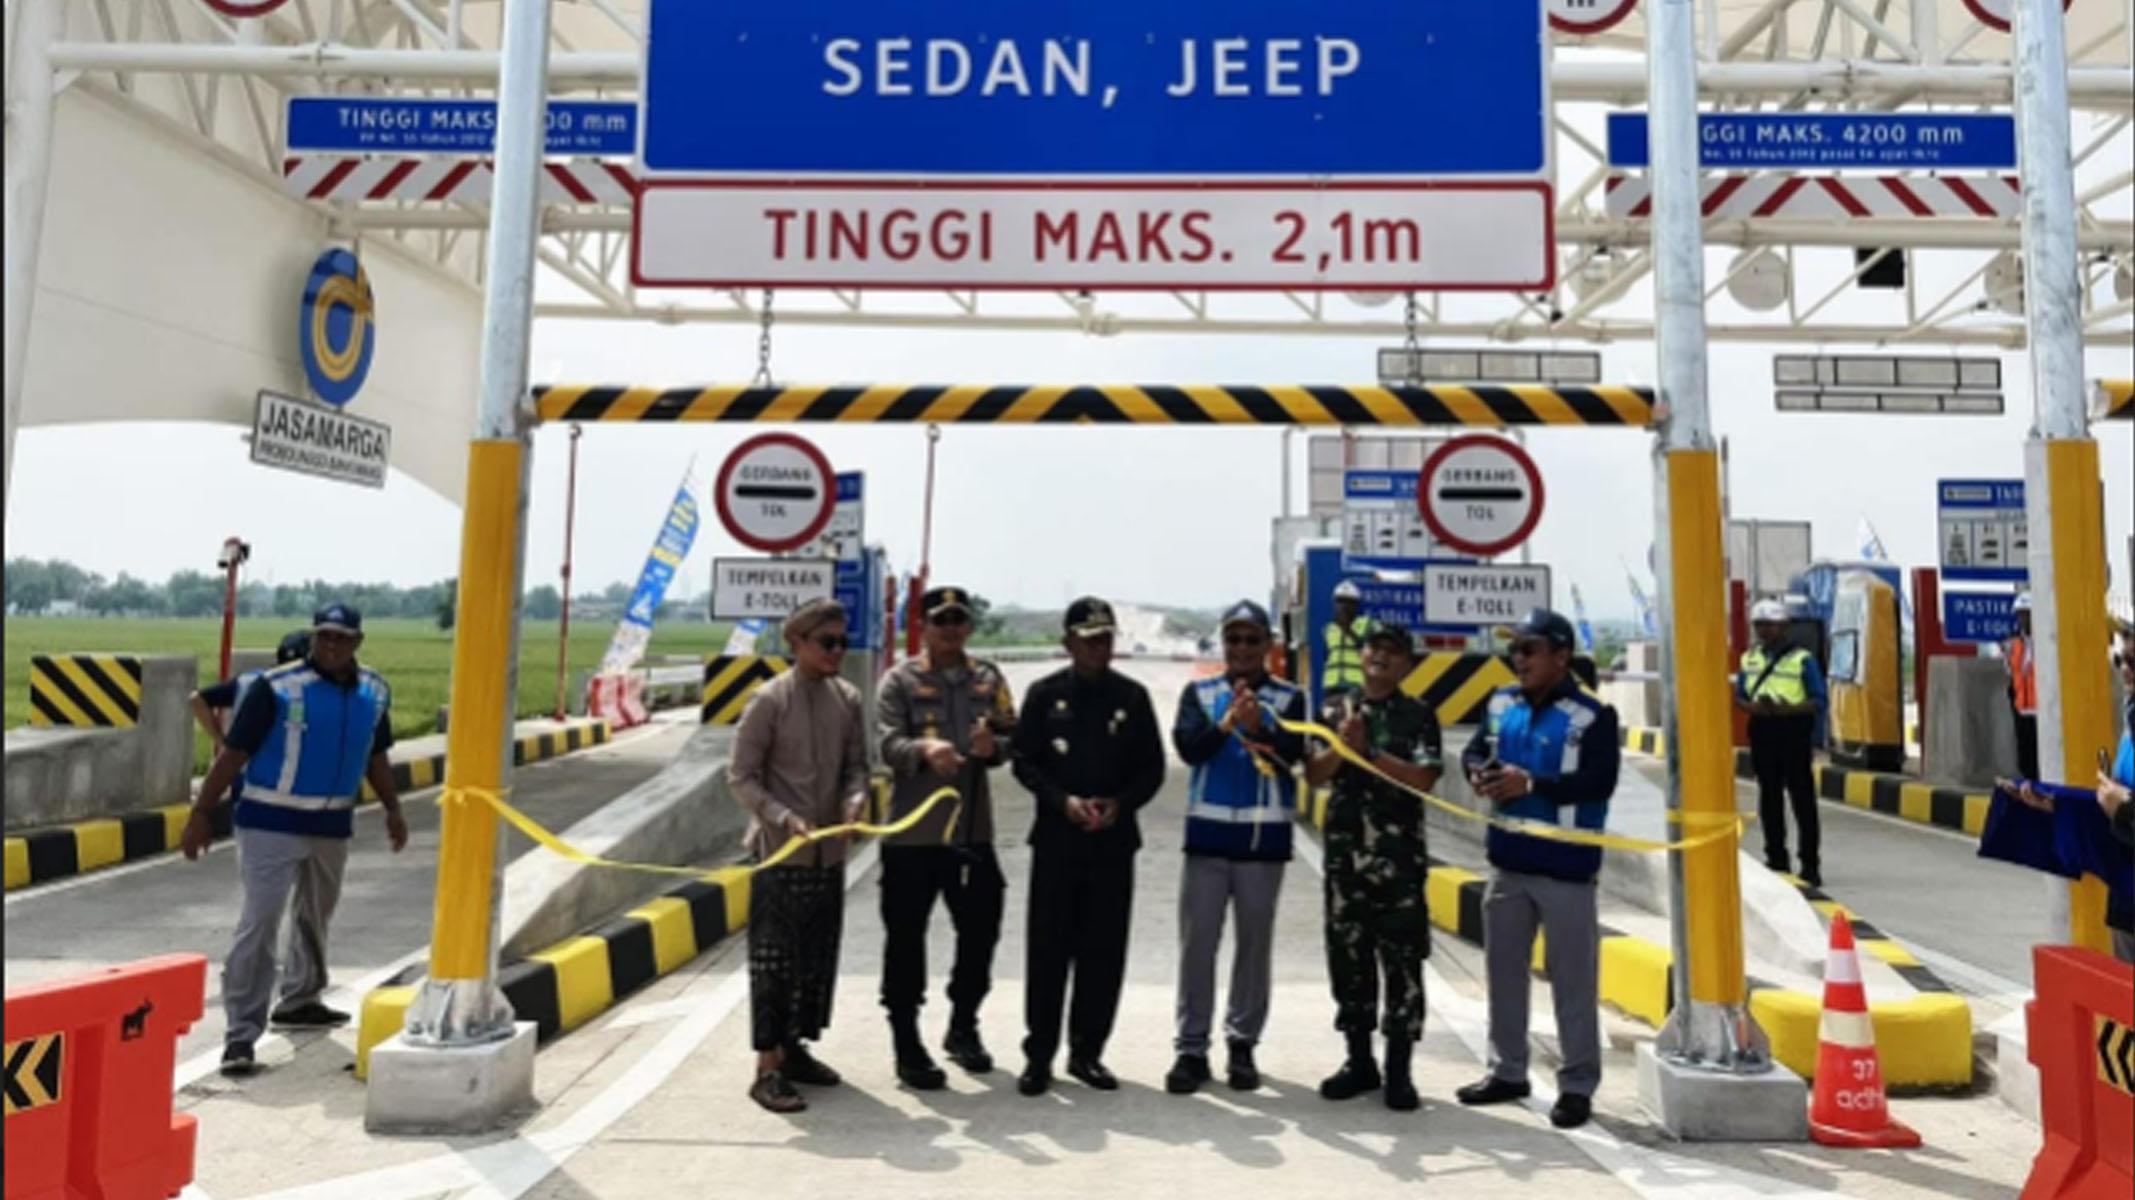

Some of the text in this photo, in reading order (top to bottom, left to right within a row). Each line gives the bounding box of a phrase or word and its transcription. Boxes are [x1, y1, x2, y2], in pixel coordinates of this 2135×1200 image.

[823, 39, 1361, 107] SEDAN, JEEP
[339, 108, 420, 129] TINGGI
[544, 110, 573, 131] 00
[1703, 123, 1963, 144] GGI MAKS. 4200 mm
[764, 209, 1421, 273] TINGGI MAKS. 2,1m
[261, 402, 385, 459] JASAMARGA
[728, 569, 823, 586] TEMPELKAN
[1437, 574, 1536, 593] TEMPELKAN
[1456, 599, 1516, 616] E-TOLL
[1852, 1059, 1875, 1081] 37
